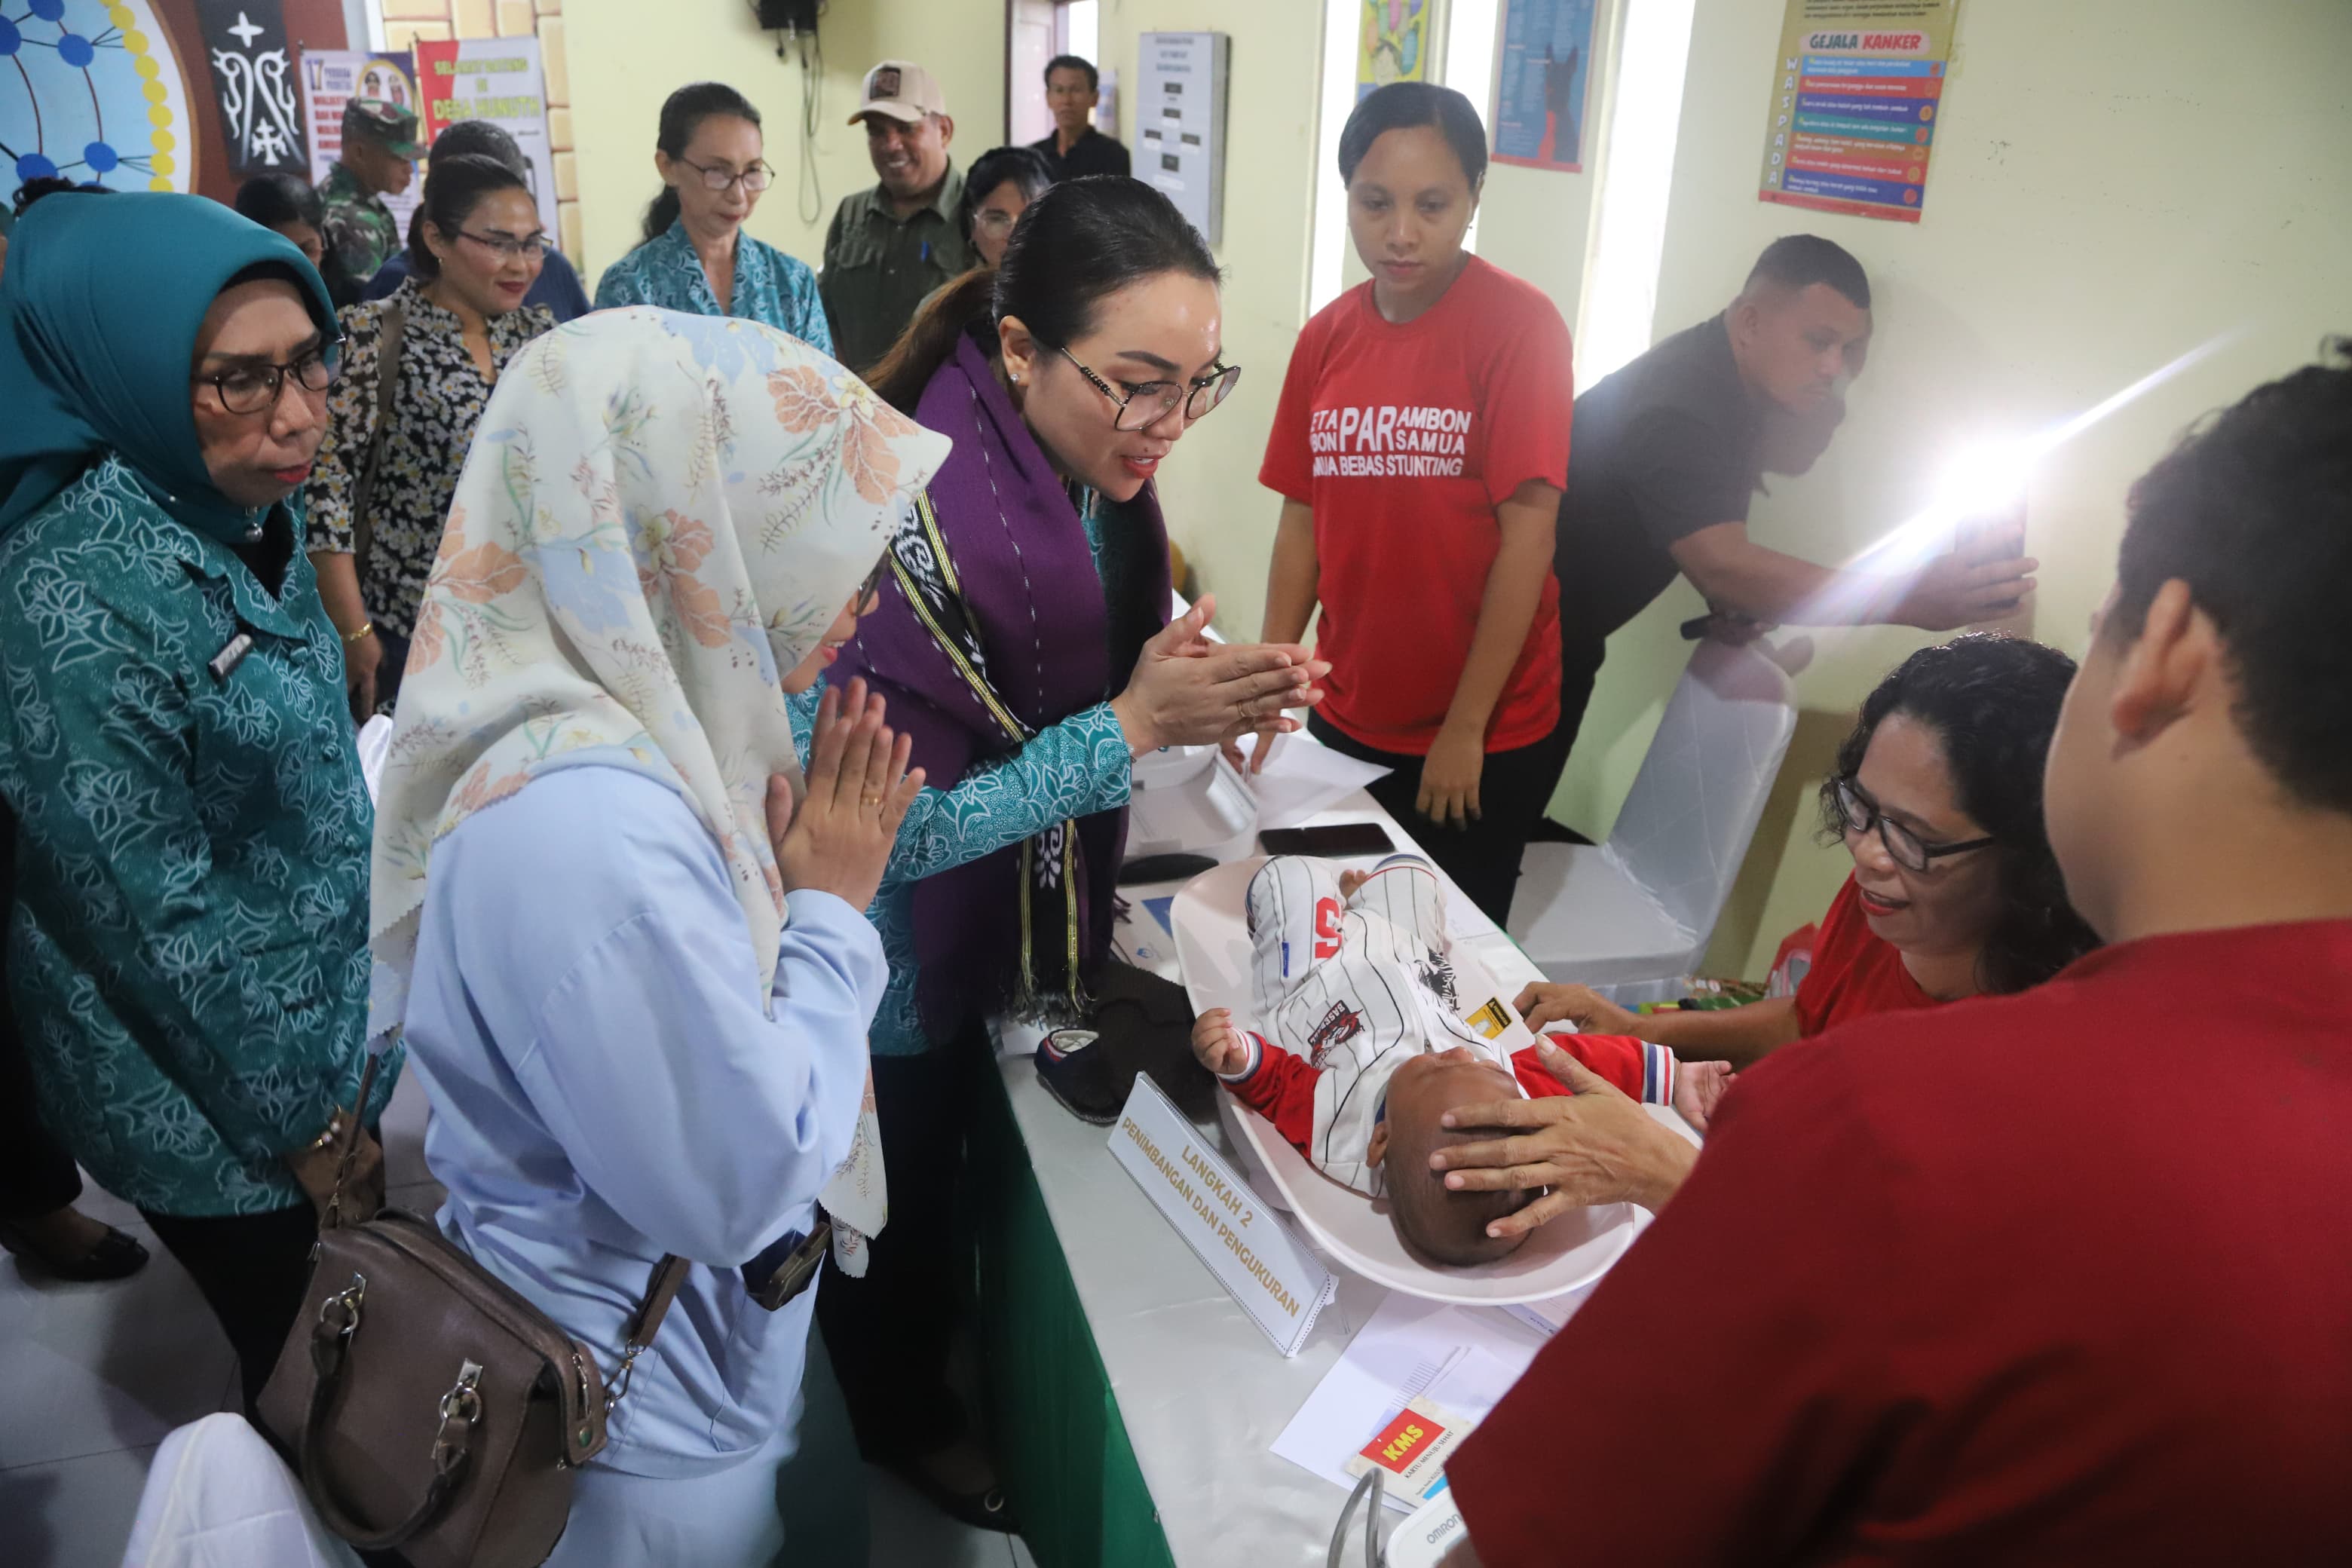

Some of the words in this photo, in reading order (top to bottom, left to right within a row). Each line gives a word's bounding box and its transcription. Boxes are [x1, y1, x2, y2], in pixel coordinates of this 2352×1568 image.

[1809, 34, 1858, 50] GEJALA
[1862, 33, 1922, 51] KANKER
[432, 99, 472, 121] DESA
[1309, 430, 1337, 453] BON
[1395, 429, 1465, 455] SAMUA
[1310, 409, 1338, 433] ETA
[1339, 406, 1397, 452] PAR
[1396, 406, 1472, 434] AMBON
[1312, 455, 1339, 477] MUA
[1340, 455, 1385, 476] BEBAS
[1386, 454, 1463, 477] STUNTING
[1181, 1144, 1244, 1217] LANGKAH
[1242, 1210, 1254, 1229] 2
[1120, 1116, 1196, 1204] PENIMBANGAN
[1191, 1195, 1220, 1232] DAN
[1216, 1221, 1300, 1318] PENGUKURAN
[1381, 1423, 1424, 1462] KMS
[1404, 1461, 1423, 1480] KARTU
[1420, 1444, 1441, 1465] MENUJU
[1438, 1429, 1455, 1447] SEHAT
